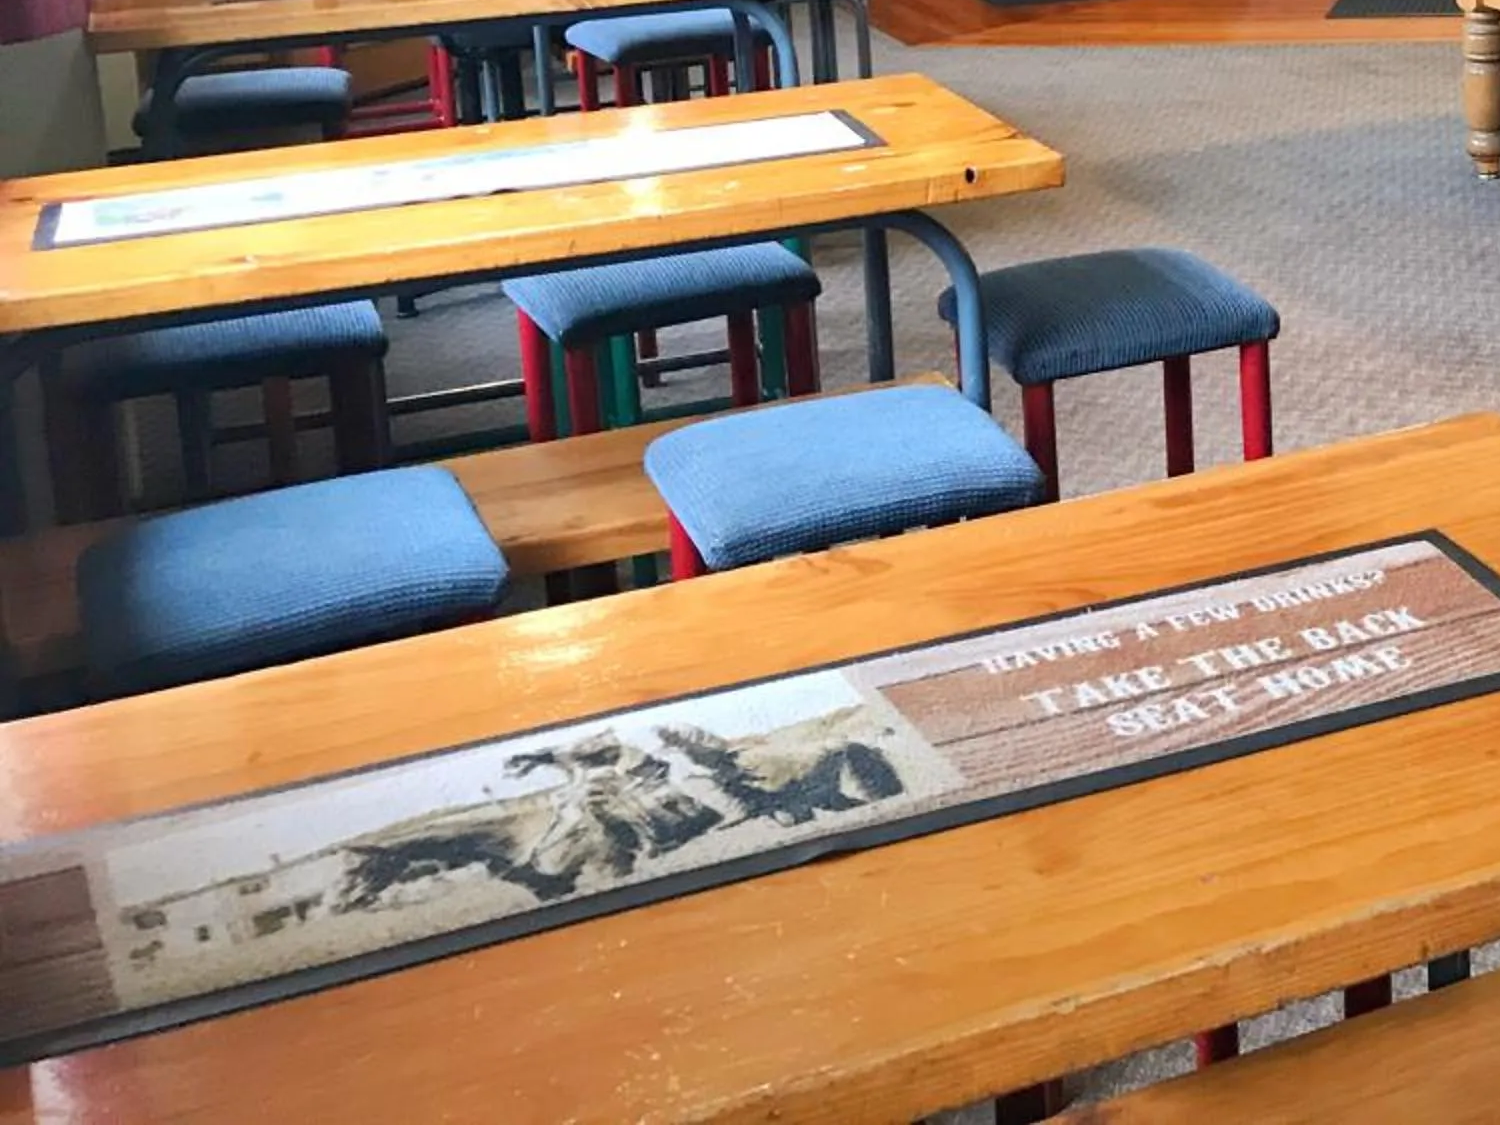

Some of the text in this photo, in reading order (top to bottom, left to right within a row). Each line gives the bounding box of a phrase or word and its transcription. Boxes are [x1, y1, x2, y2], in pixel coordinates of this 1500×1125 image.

[979, 569, 1387, 674] HAVING A FEW DRINKS?
[1018, 605, 1430, 716] TAKE THE BACK
[1105, 645, 1413, 737] SEAT HOME
